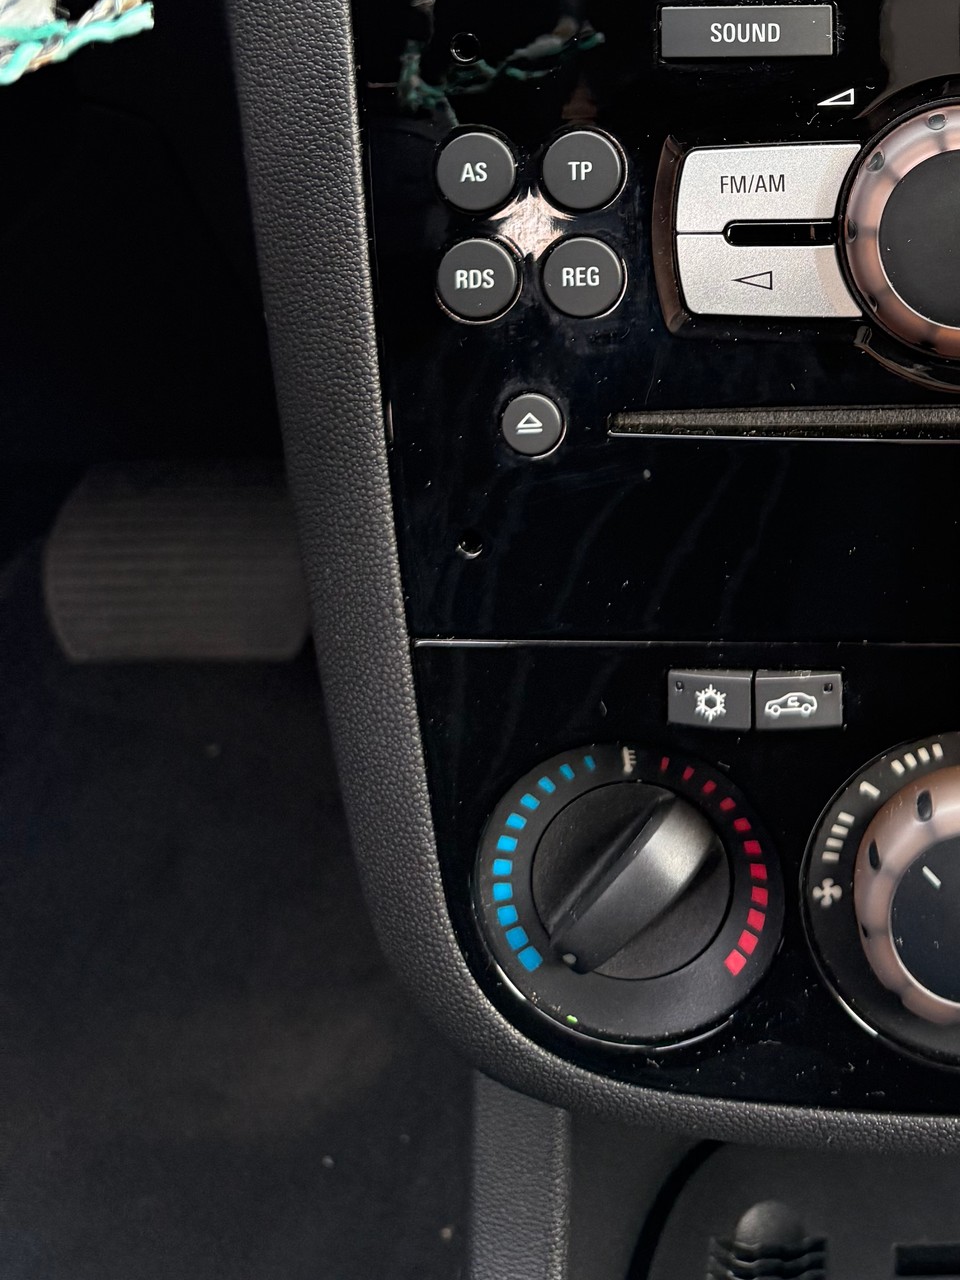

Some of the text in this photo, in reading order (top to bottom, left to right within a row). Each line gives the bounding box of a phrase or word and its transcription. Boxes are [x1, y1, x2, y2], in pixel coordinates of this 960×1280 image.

[709, 21, 782, 44] SOUND
[459, 161, 489, 183] AS
[567, 160, 594, 182] TP
[719, 173, 786, 195] FM/AM
[454, 267, 496, 290] RDS
[561, 265, 601, 288] REG
[858, 780, 881, 798] 1
